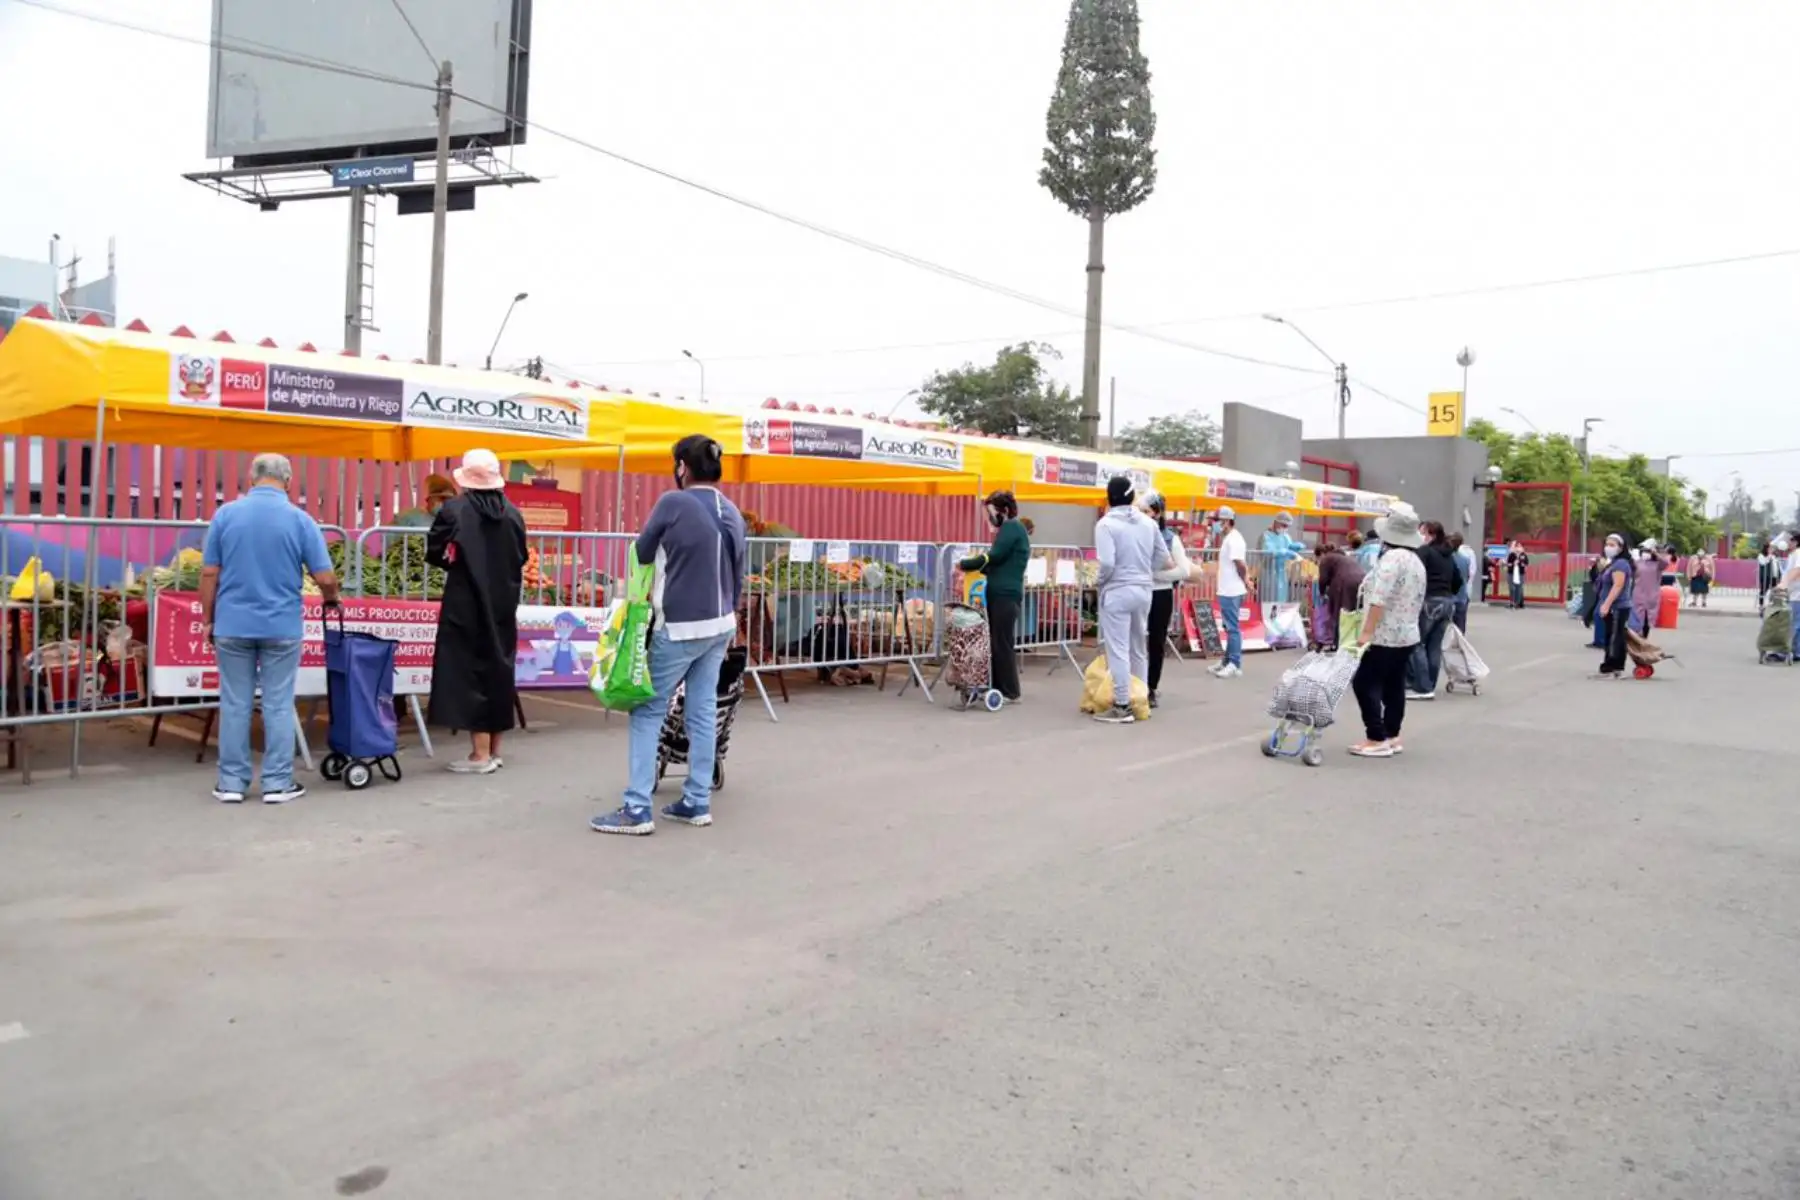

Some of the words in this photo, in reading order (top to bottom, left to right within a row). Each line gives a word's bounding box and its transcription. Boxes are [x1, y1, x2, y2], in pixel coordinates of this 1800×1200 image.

[350, 168, 372, 178] Clear
[373, 164, 407, 177] Channel
[225, 368, 262, 391] PERÚ
[273, 370, 335, 390] Ministerio
[272, 388, 288, 403] de
[291, 389, 357, 409] Agricultura
[359, 398, 366, 412] y
[368, 396, 400, 415] Riego
[1428, 404, 1456, 423] 15
[344, 607, 366, 619] MIS
[369, 608, 437, 621] PRODUCTOS
[385, 626, 406, 638] MIS
[188, 641, 199, 655] Y
